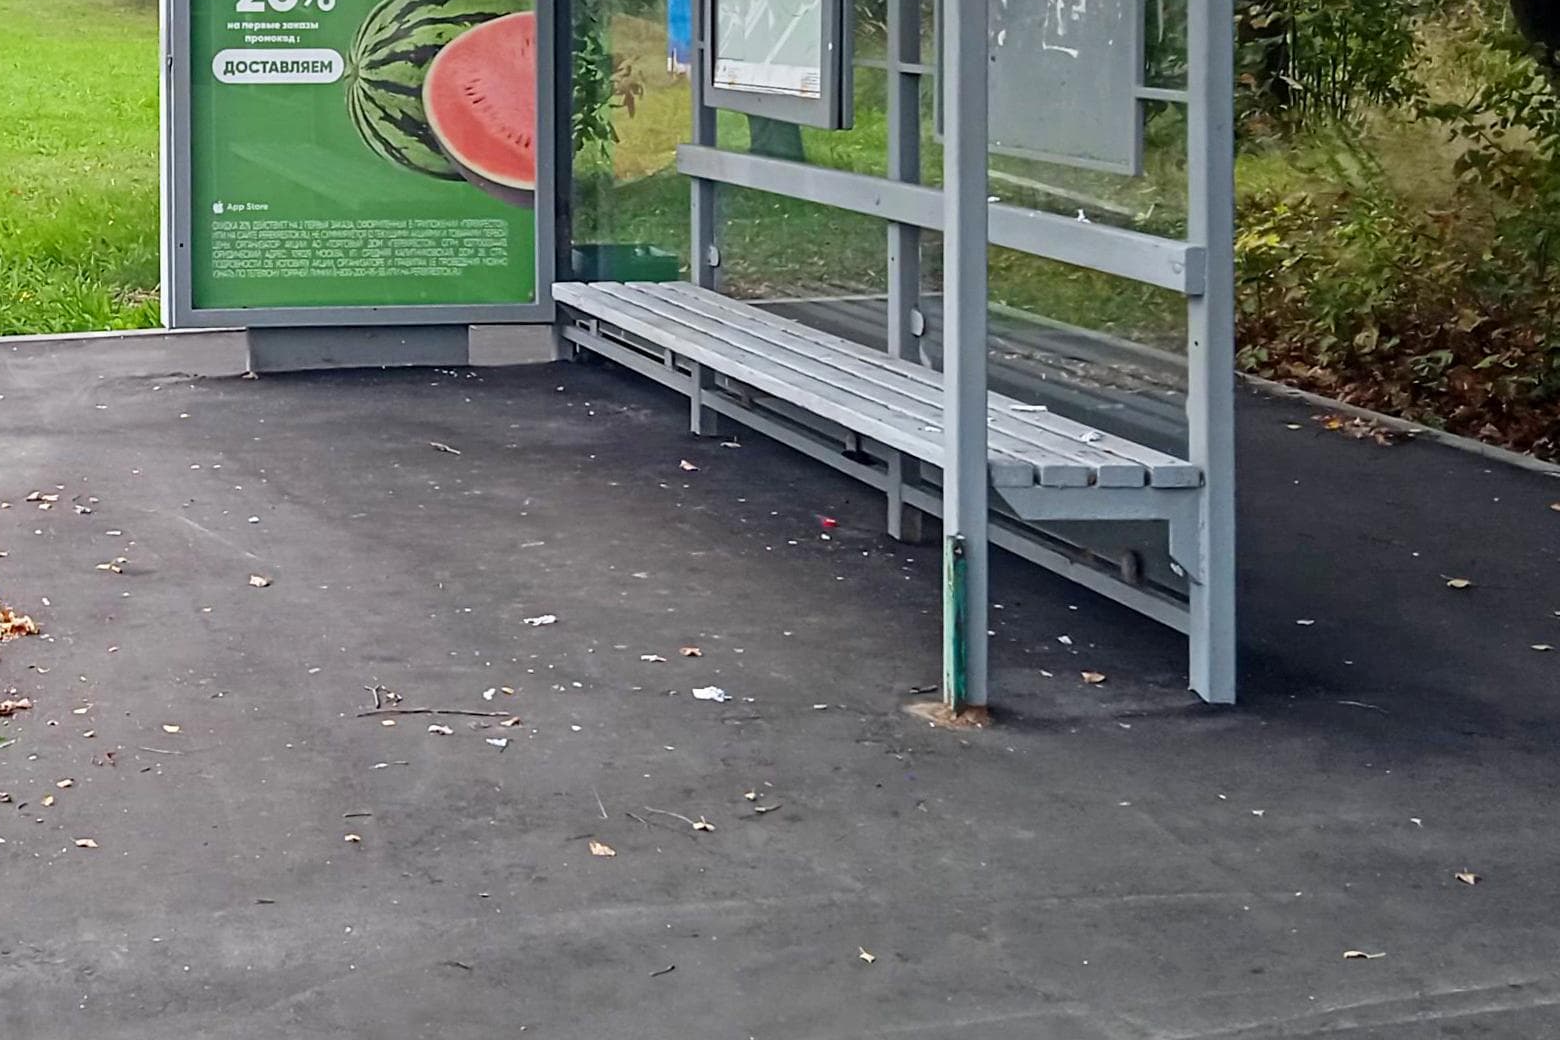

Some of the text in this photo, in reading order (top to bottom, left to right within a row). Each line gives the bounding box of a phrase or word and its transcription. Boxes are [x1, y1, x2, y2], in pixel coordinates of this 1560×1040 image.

[241, 22, 281, 31] первые
[223, 61, 333, 75] ДОСТАВЛЯЕМ
[227, 202, 269, 212] App Store
